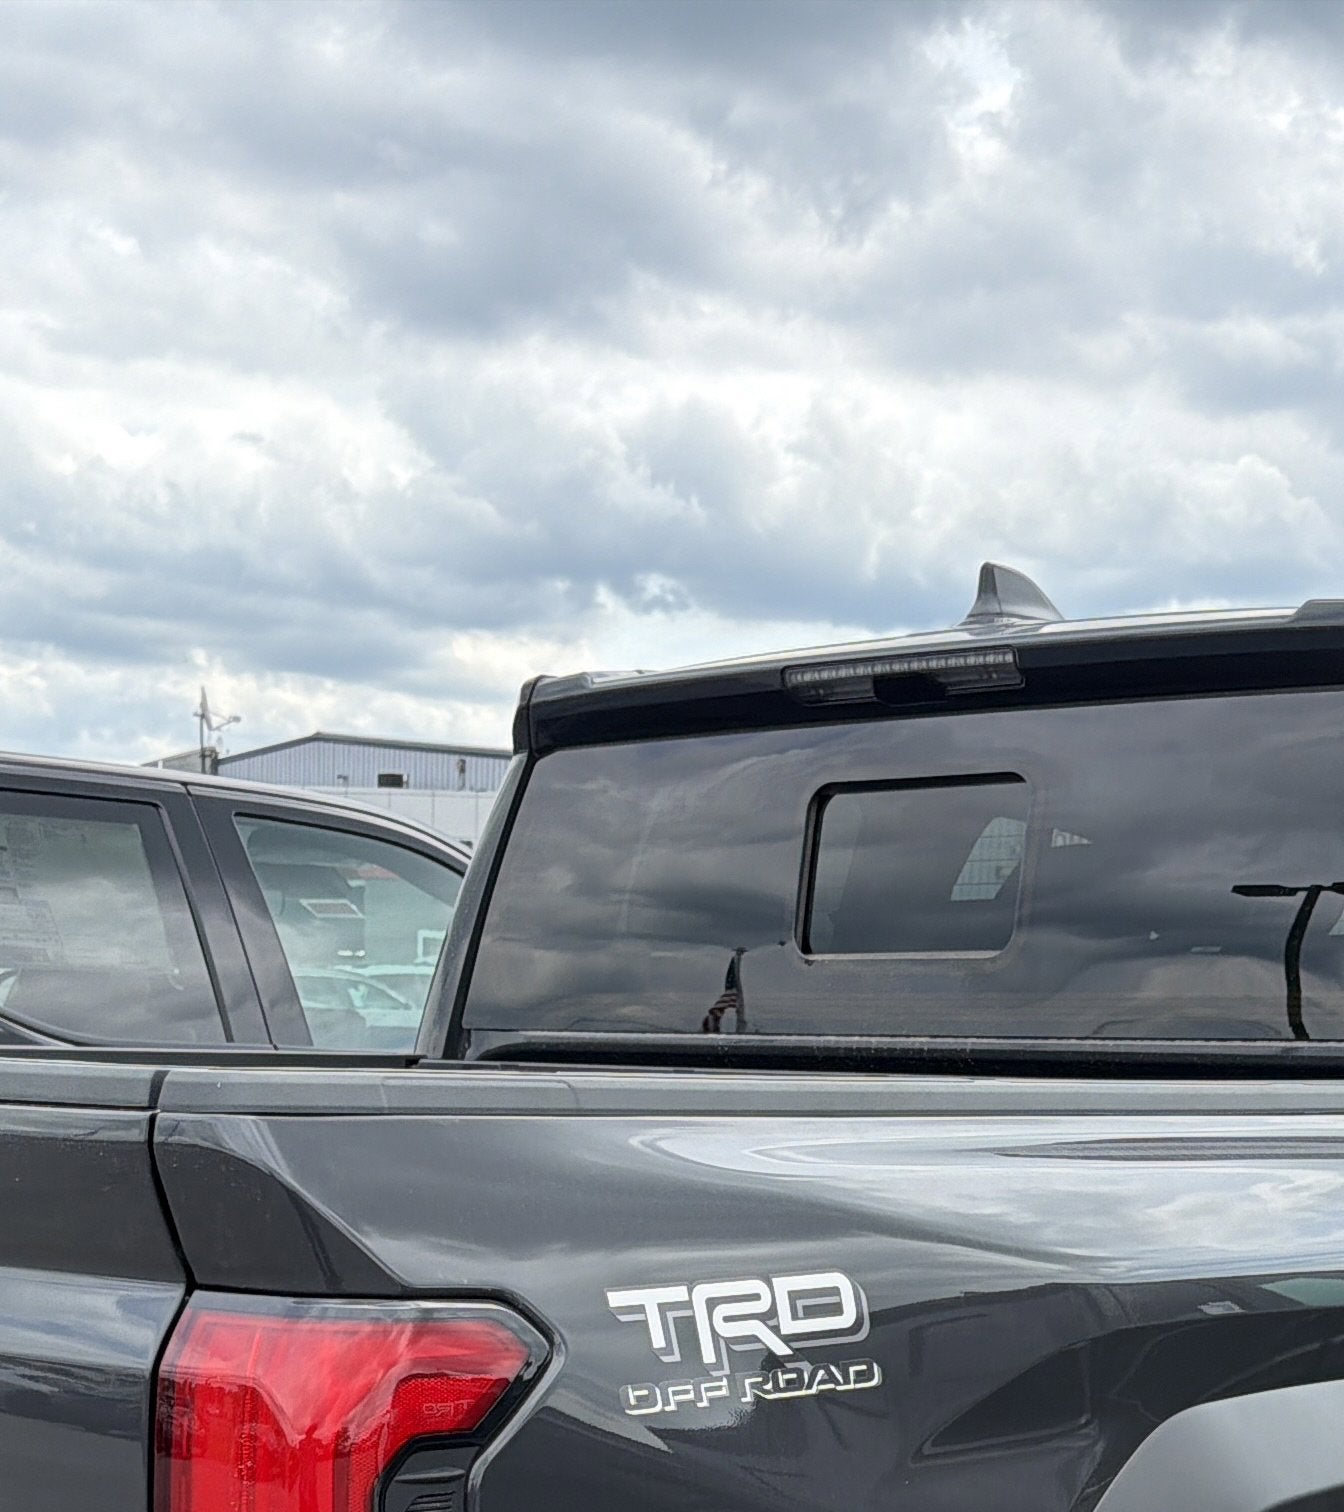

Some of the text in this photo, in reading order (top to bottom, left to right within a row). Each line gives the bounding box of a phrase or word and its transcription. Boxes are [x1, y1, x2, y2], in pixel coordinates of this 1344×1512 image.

[606, 1271, 869, 1376] TRD
[619, 1358, 882, 1415] OFF ROAD
